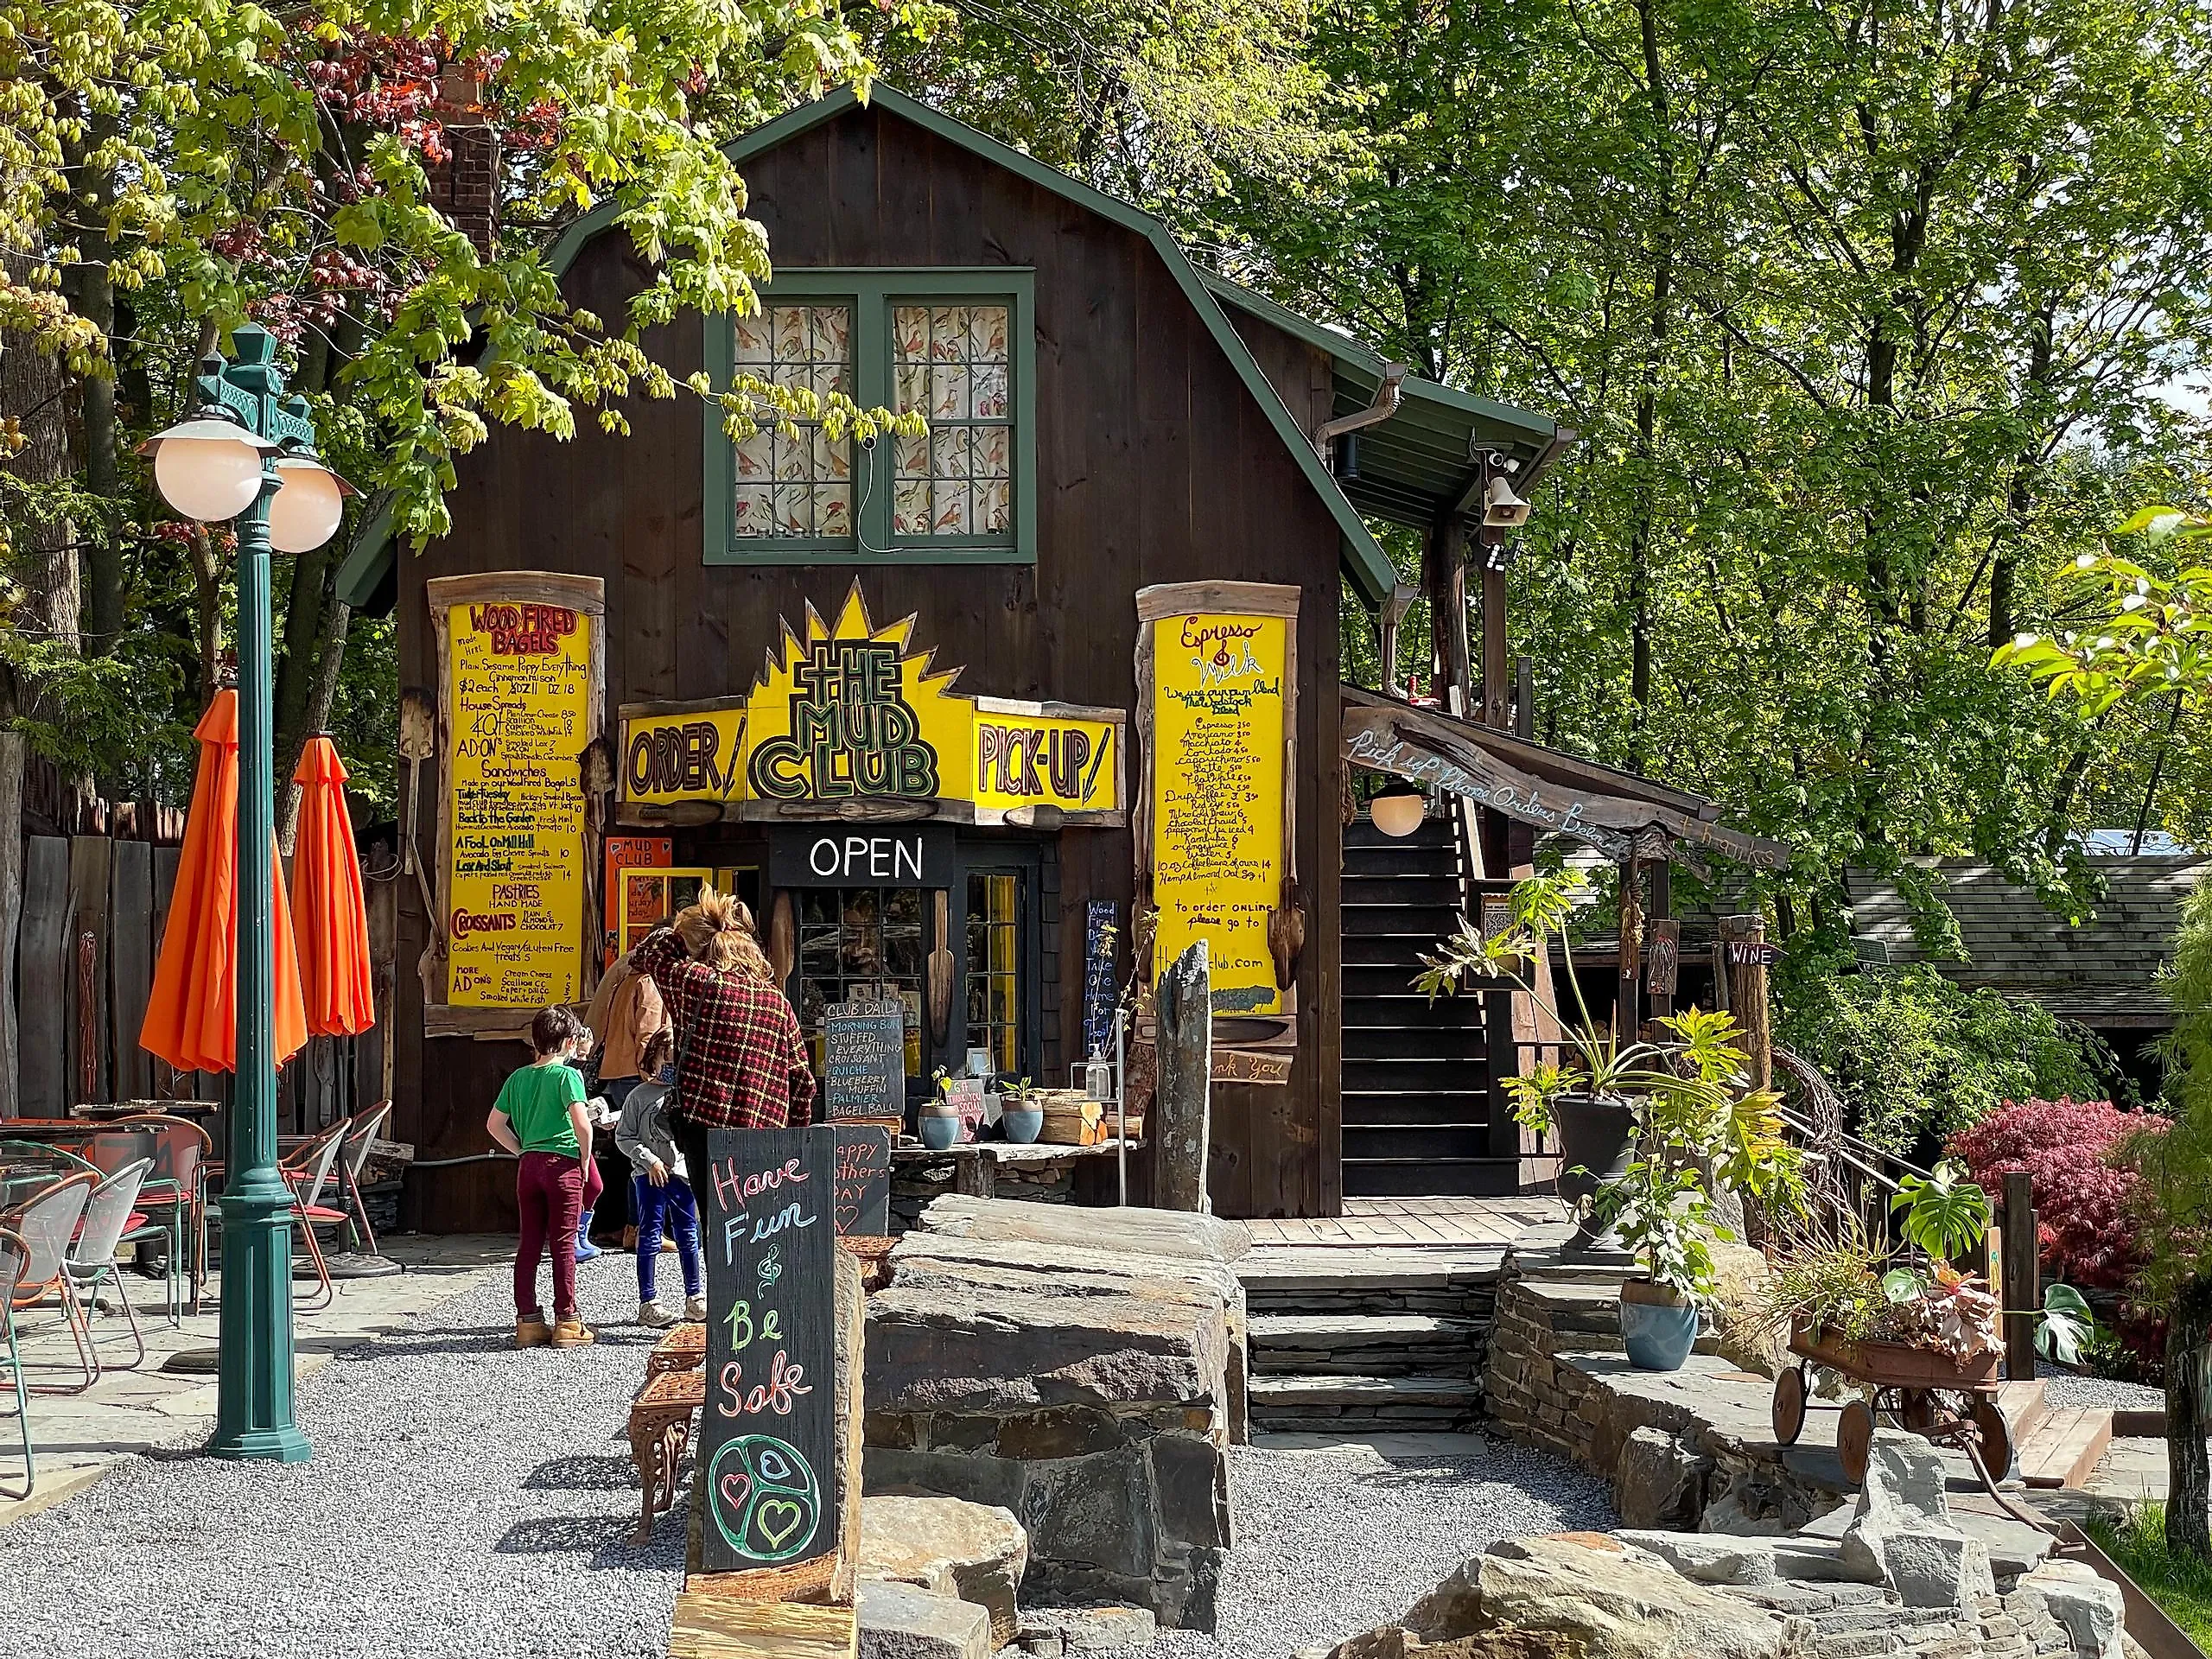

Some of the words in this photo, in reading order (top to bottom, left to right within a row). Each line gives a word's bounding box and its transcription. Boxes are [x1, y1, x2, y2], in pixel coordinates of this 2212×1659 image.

[470, 604, 519, 632] WOOD
[522, 605, 578, 635] FIRED
[493, 632, 559, 655] BAGELS
[1180, 615, 1263, 657] Espresso
[797, 644, 899, 709] THE
[460, 696, 493, 712] House
[493, 696, 526, 713] Spreads
[797, 700, 914, 752] MUD
[1195, 717, 1235, 732] Espresso
[1179, 737, 1232, 748] Macchiato
[1183, 729, 1235, 740] Americano
[627, 721, 721, 797] ORDER
[978, 723, 1091, 799] PICK-UP
[481, 760, 547, 778] Sandwiches
[751, 741, 937, 800] CLUB
[1346, 729, 1404, 769] Pick
[1400, 755, 1442, 778] up
[1493, 786, 1556, 823] Orders
[623, 840, 652, 851] MUD
[616, 853, 652, 865] CLUB
[809, 836, 925, 880] OPEN
[1158, 861, 1167, 872] 10
[1262, 859, 1272, 869] 14
[1088, 901, 1115, 915] Wood
[1175, 899, 1187, 912] to
[1192, 900, 1226, 912] order
[451, 907, 516, 940] CROISSANTS
[1187, 913, 1221, 931] please
[1227, 919, 1239, 931] go
[1247, 916, 1259, 928] to
[456, 965, 478, 974] MORE
[827, 1003, 859, 1017] CLUB
[865, 1001, 899, 1014] DAILY
[830, 1033, 876, 1045] STUFFED
[836, 1043, 902, 1054] EVERYTHING
[829, 1053, 887, 1065] CROISSANT
[1248, 1054, 1284, 1080] You
[832, 1065, 868, 1076] QUICHE
[830, 1075, 887, 1087] BLUEBERRY
[849, 1084, 887, 1094] MUFFIN
[954, 1082, 961, 1093] 6
[833, 1093, 880, 1104] PALMIER
[968, 1092, 982, 1101] YOU
[833, 1105, 863, 1117] BAGEL
[868, 1103, 898, 1115] BALL
[959, 1102, 983, 1112] SOCIAL
[836, 1143, 879, 1163] appy
[711, 1156, 810, 1213] Have
[723, 1202, 818, 1267] Fun
[723, 1300, 785, 1356] Be
[717, 1349, 814, 1418] Safe
